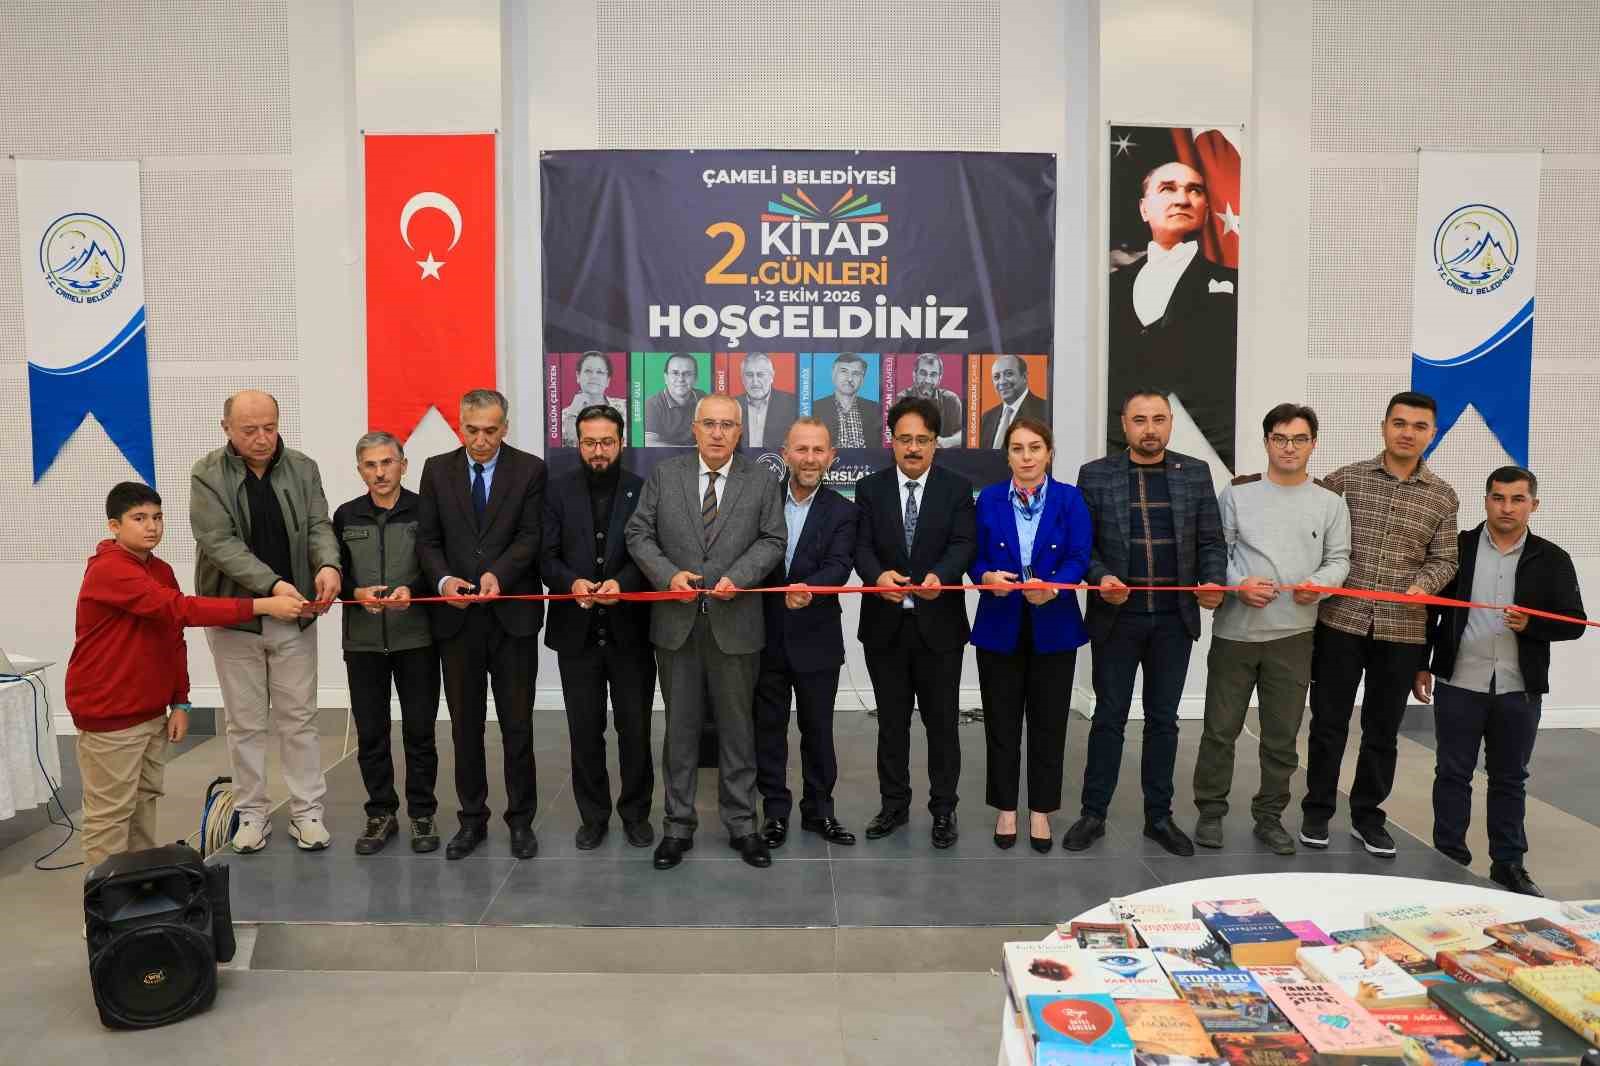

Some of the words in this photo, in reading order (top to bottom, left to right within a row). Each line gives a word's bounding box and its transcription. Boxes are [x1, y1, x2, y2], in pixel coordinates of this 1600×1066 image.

[702, 164, 777, 188] ÇAMELİ
[783, 165, 896, 185] BELEDİYESİ
[761, 214, 889, 256] KİTAP
[758, 255, 888, 286] GÜNLERİ
[753, 290, 775, 303] 1-2
[779, 286, 819, 303] EKİM
[823, 290, 861, 303] 2026
[649, 294, 969, 348] HOŞGELDİNİZ
